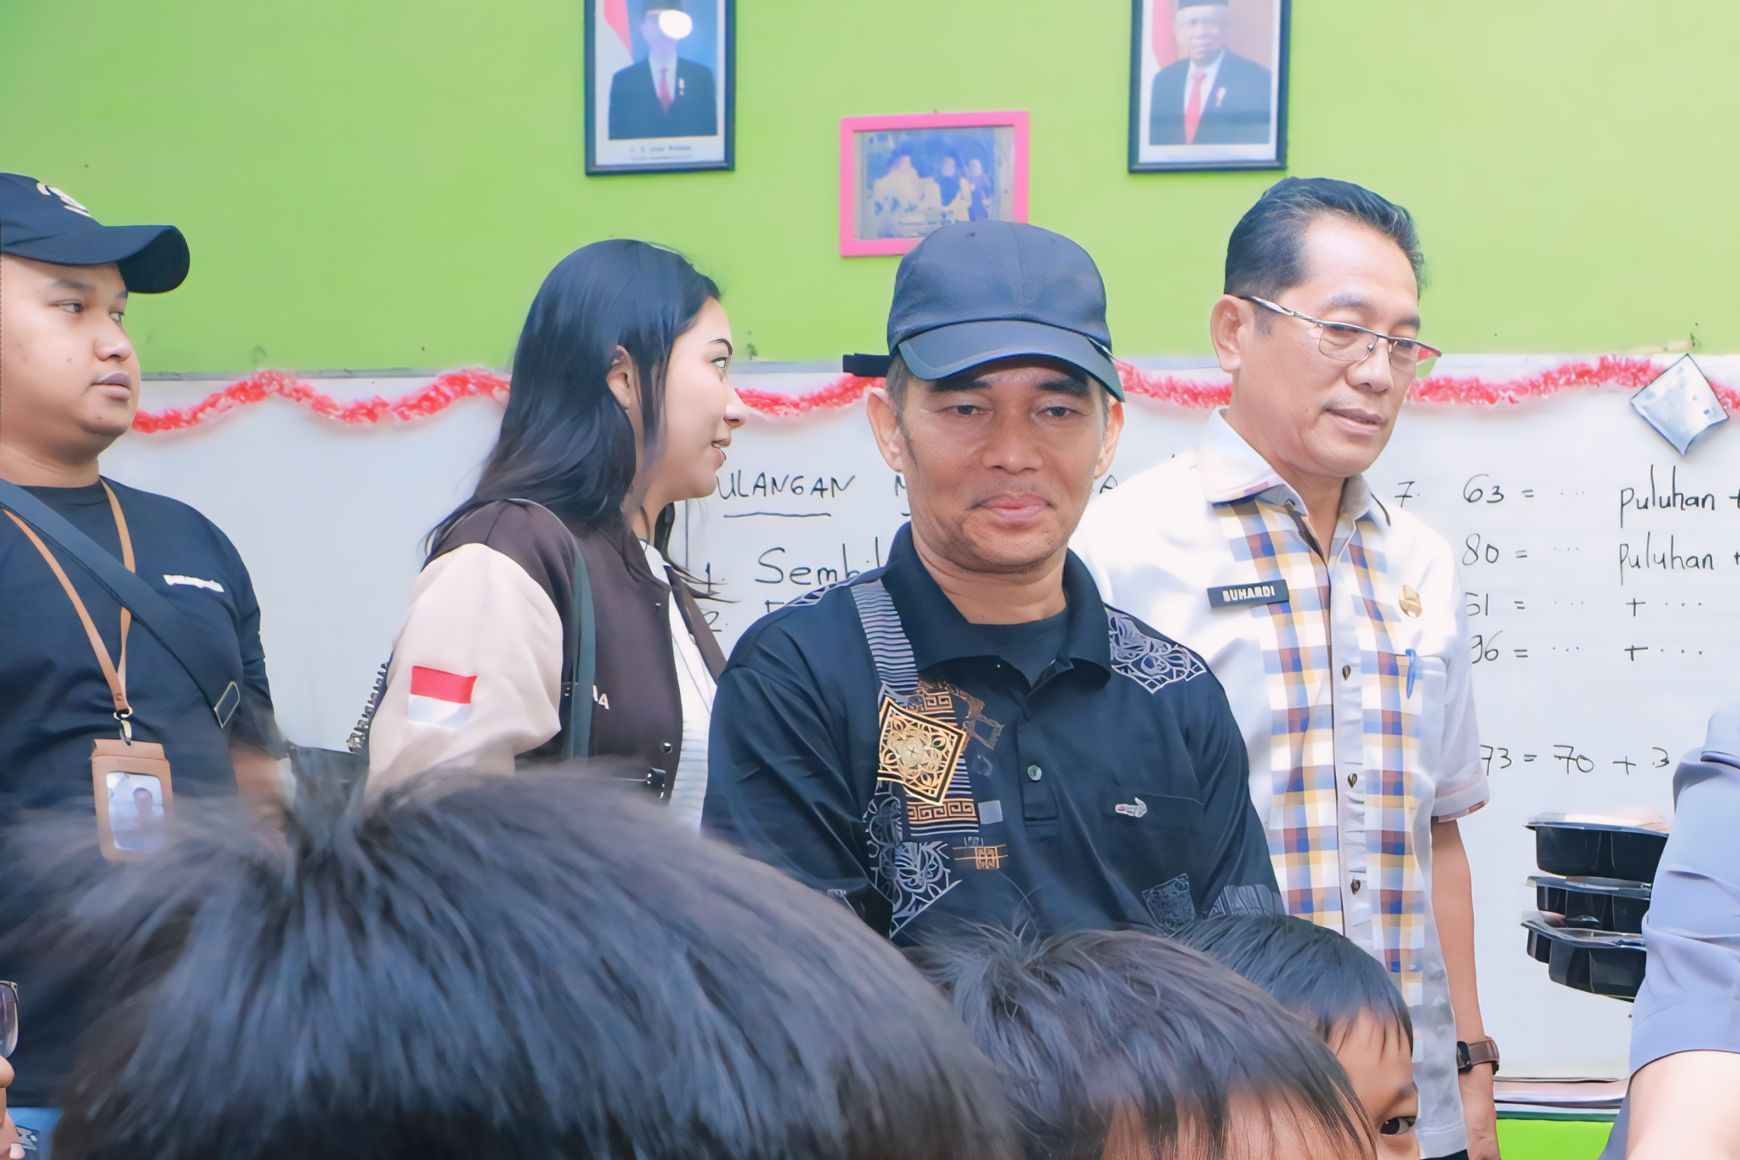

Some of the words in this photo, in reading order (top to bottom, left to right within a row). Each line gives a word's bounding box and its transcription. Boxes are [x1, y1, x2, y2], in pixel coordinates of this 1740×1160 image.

[716, 469, 856, 500] ULANGAN
[1462, 473, 1505, 504] 63
[1620, 464, 1716, 529] puluhan
[1461, 532, 1500, 567] 80
[1618, 531, 1715, 587] puluhan
[1480, 744, 1512, 777] 73
[1553, 744, 1595, 775] 70
